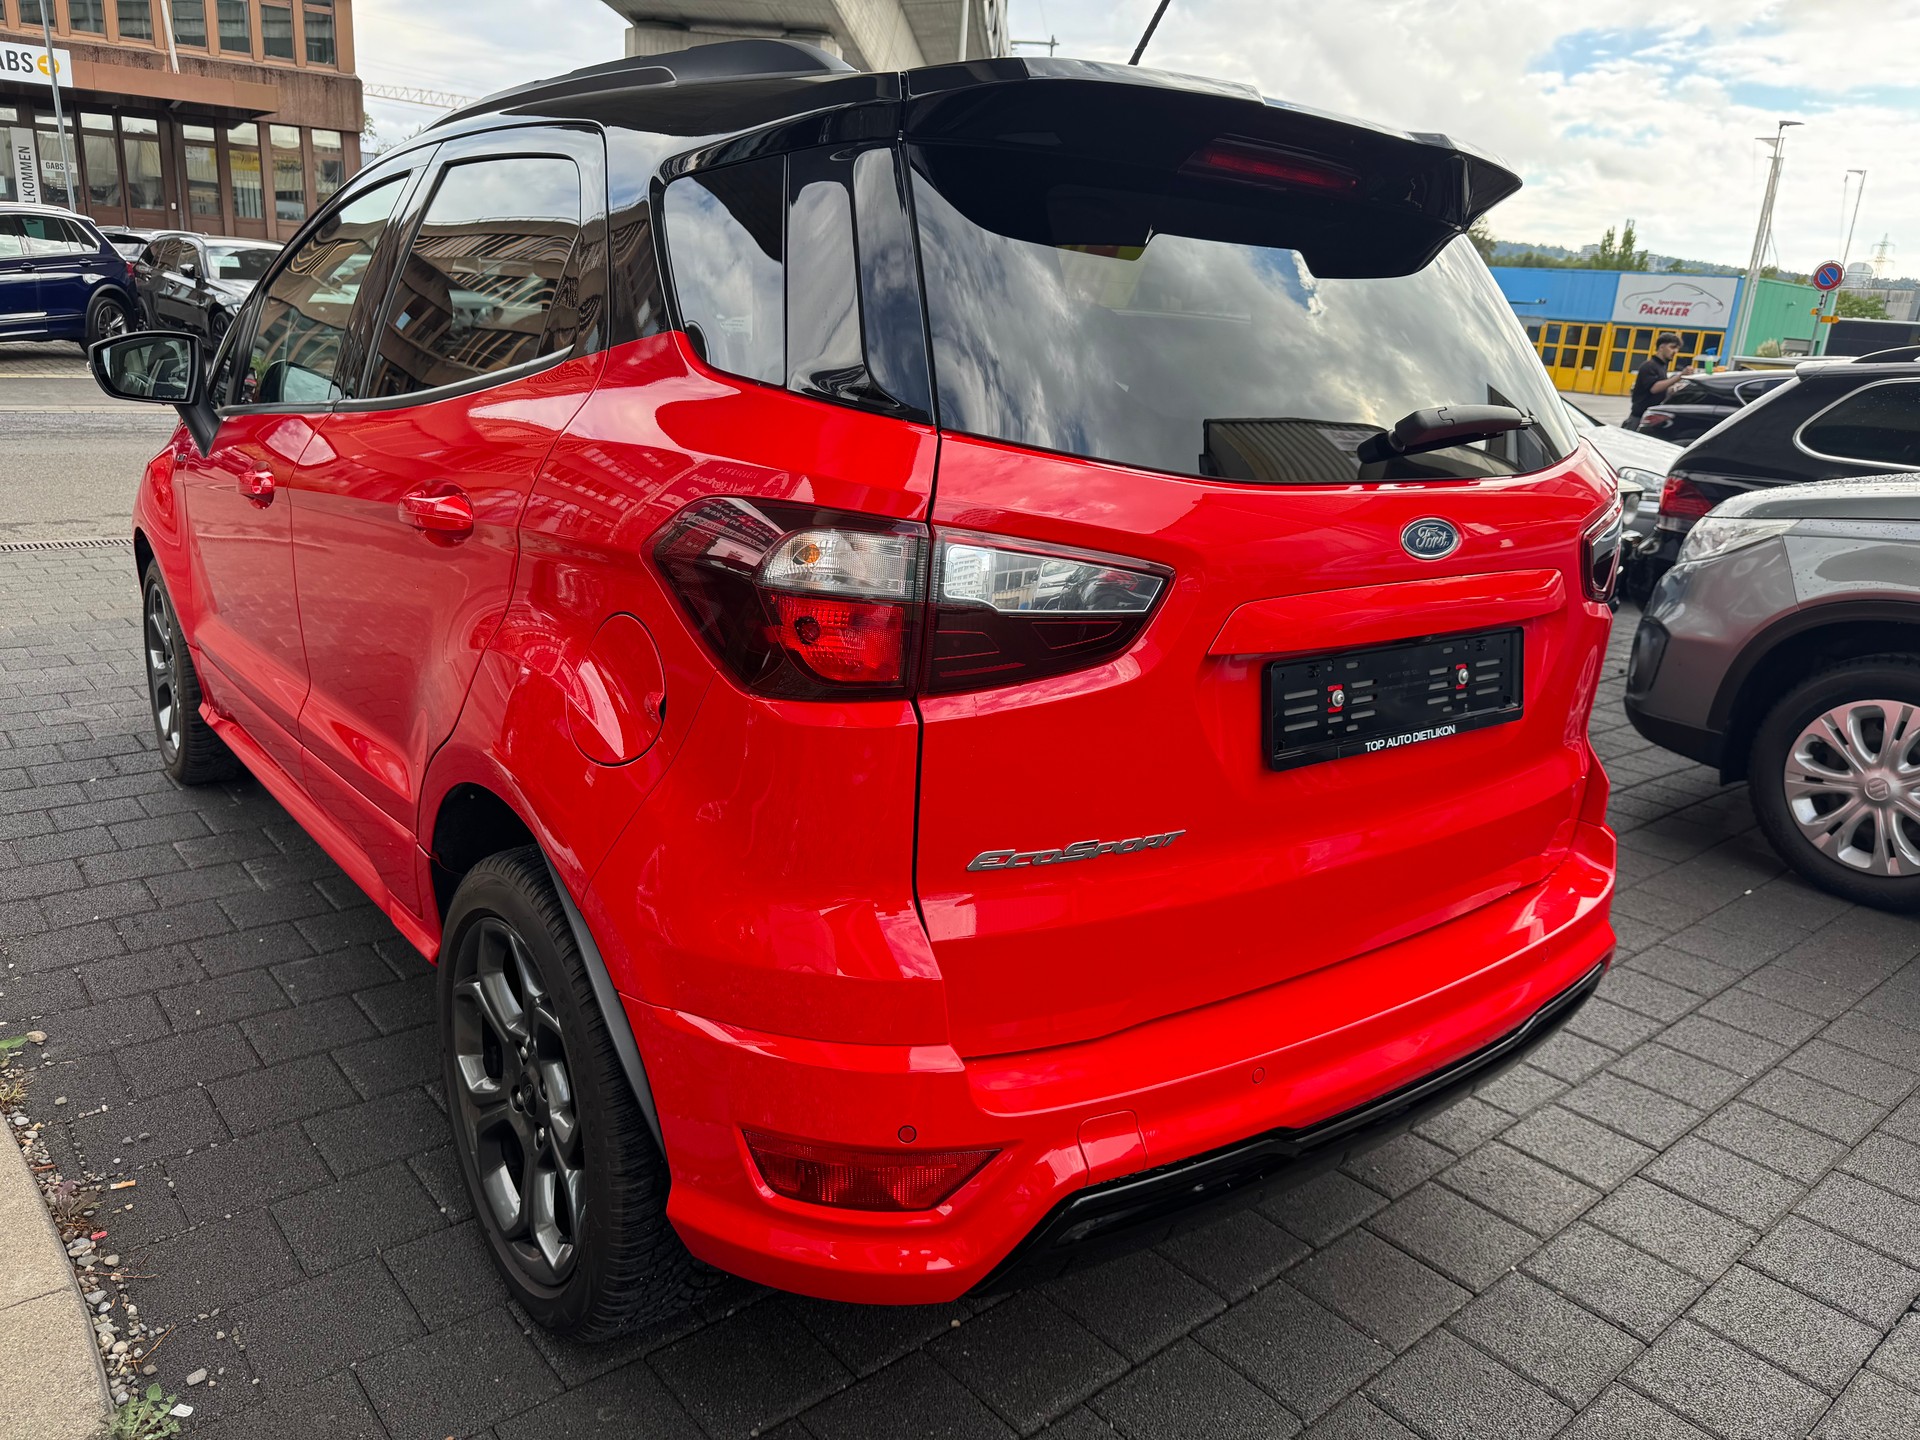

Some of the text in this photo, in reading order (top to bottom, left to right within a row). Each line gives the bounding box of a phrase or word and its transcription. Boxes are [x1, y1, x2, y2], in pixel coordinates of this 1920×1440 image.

[45, 161, 65, 171] GABS
[1415, 526, 1450, 550] Ford
[1364, 724, 1456, 753] TOP AUTO DIETLIKON
